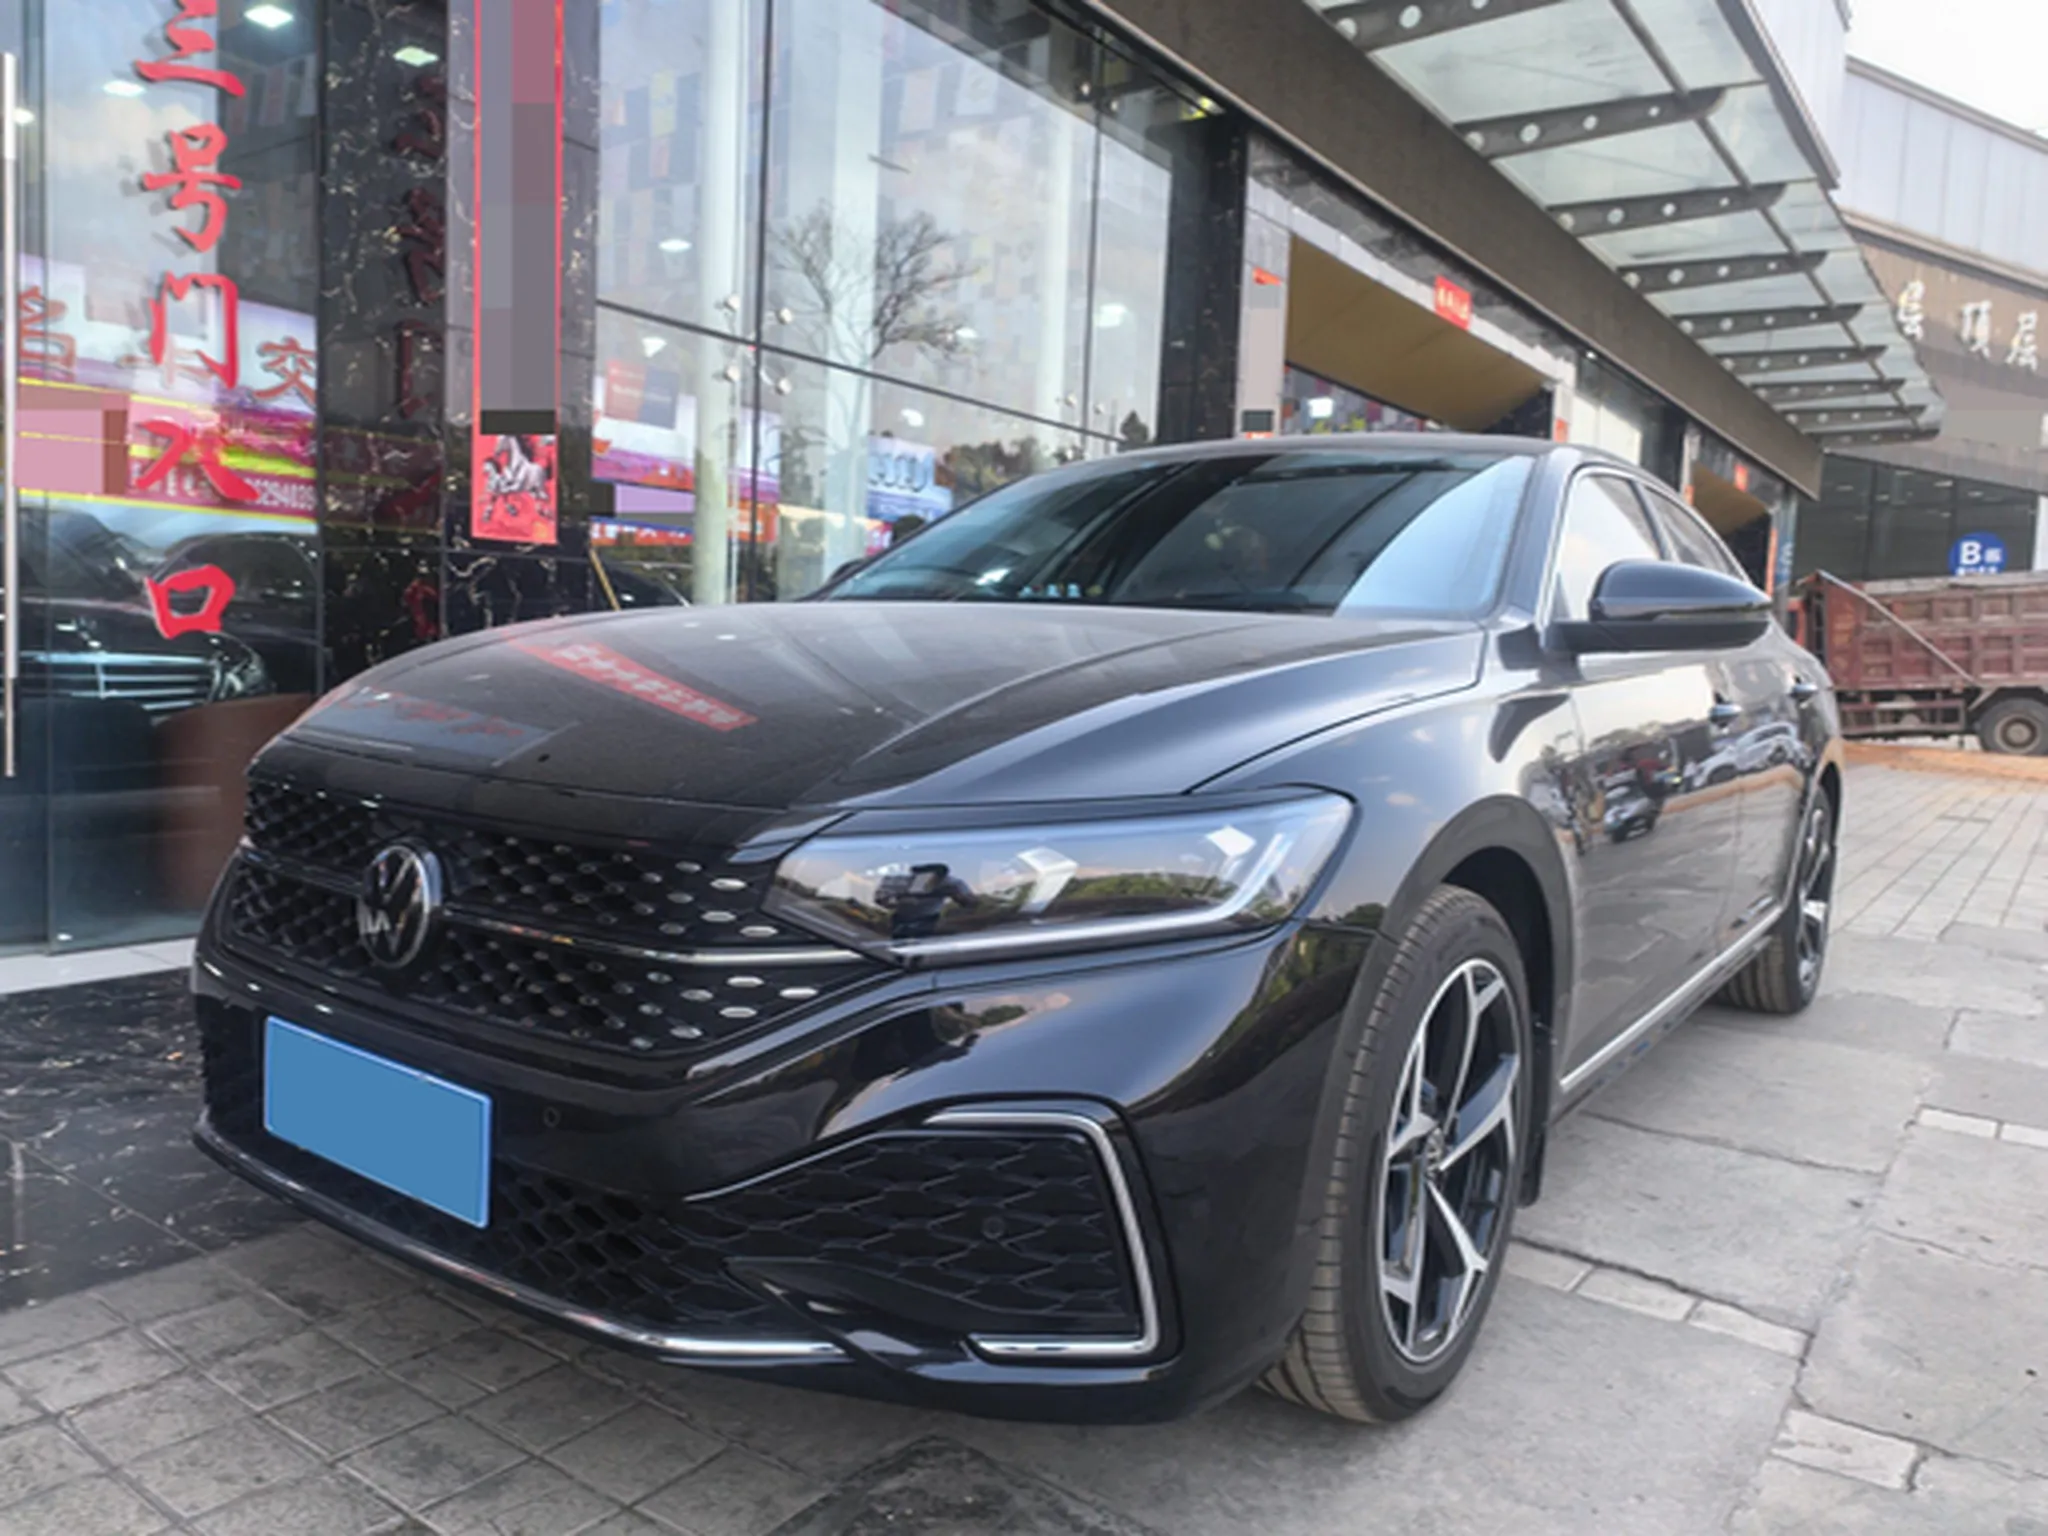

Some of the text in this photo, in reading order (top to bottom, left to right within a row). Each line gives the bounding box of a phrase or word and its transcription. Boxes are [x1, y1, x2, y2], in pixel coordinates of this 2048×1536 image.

[133, 0, 260, 639] 三号门入口
